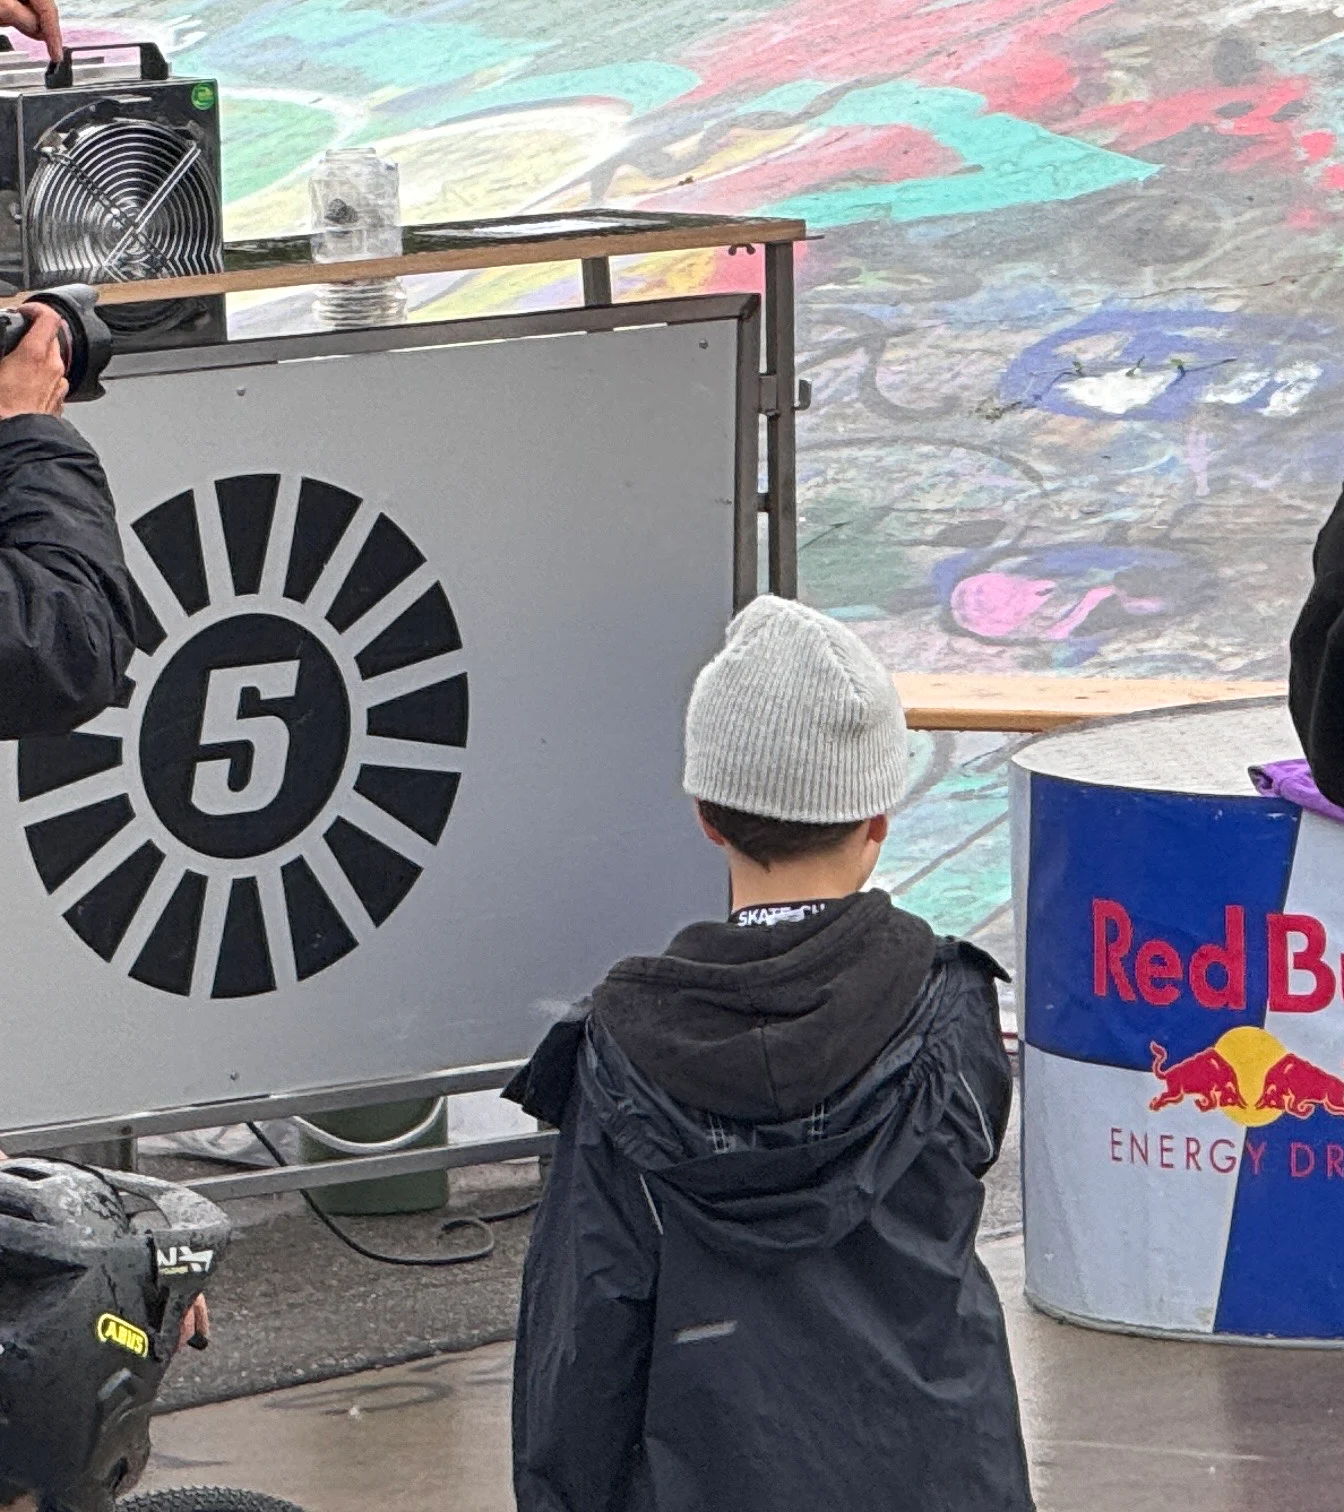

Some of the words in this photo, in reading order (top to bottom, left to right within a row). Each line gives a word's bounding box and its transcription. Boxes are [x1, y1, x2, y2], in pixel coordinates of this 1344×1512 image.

[190, 660, 300, 817] 5
[1092, 897, 1246, 1010] Red
[1111, 1127, 1267, 1174] ENERGY
[105, 1321, 143, 1355] ABUS
